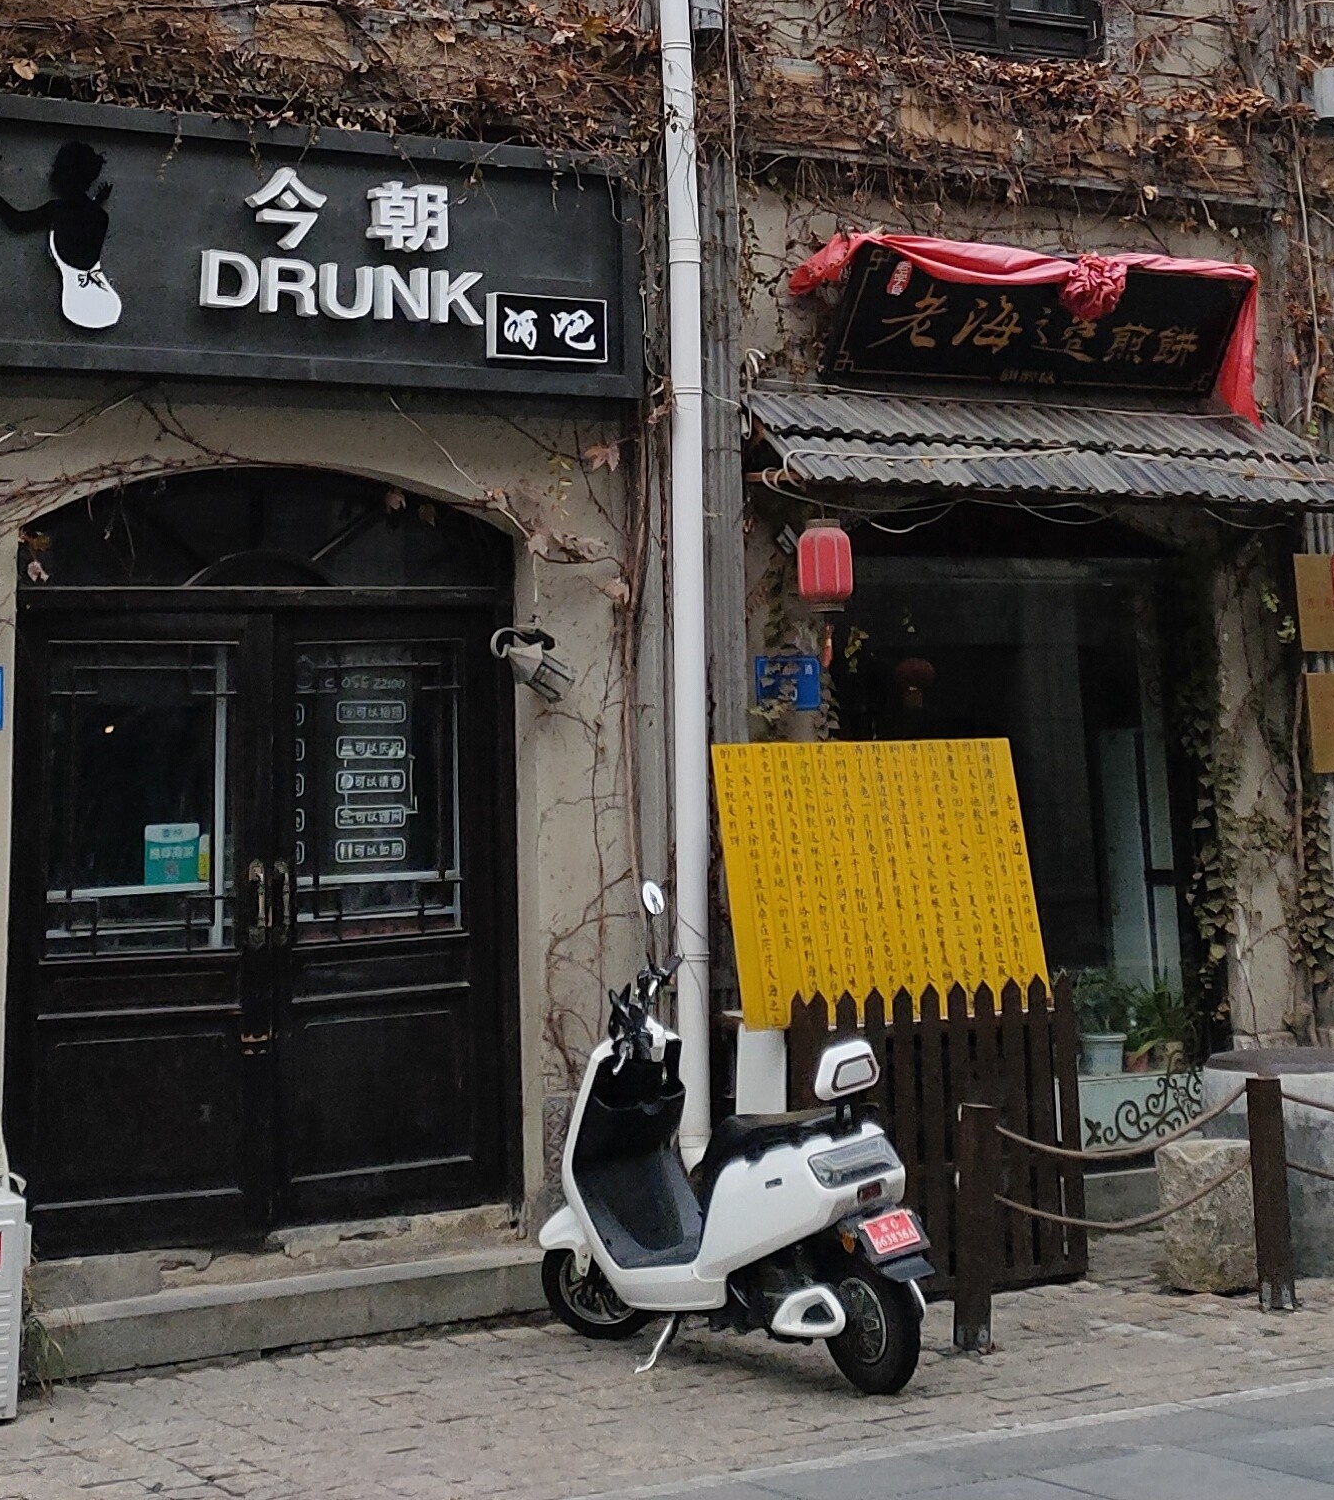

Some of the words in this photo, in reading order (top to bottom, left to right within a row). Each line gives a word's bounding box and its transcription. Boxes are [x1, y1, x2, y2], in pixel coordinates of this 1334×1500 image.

[245, 166, 450, 251] 今朝
[199, 249, 484, 326] DRUNK
[504, 305, 597, 353] 酒吧
